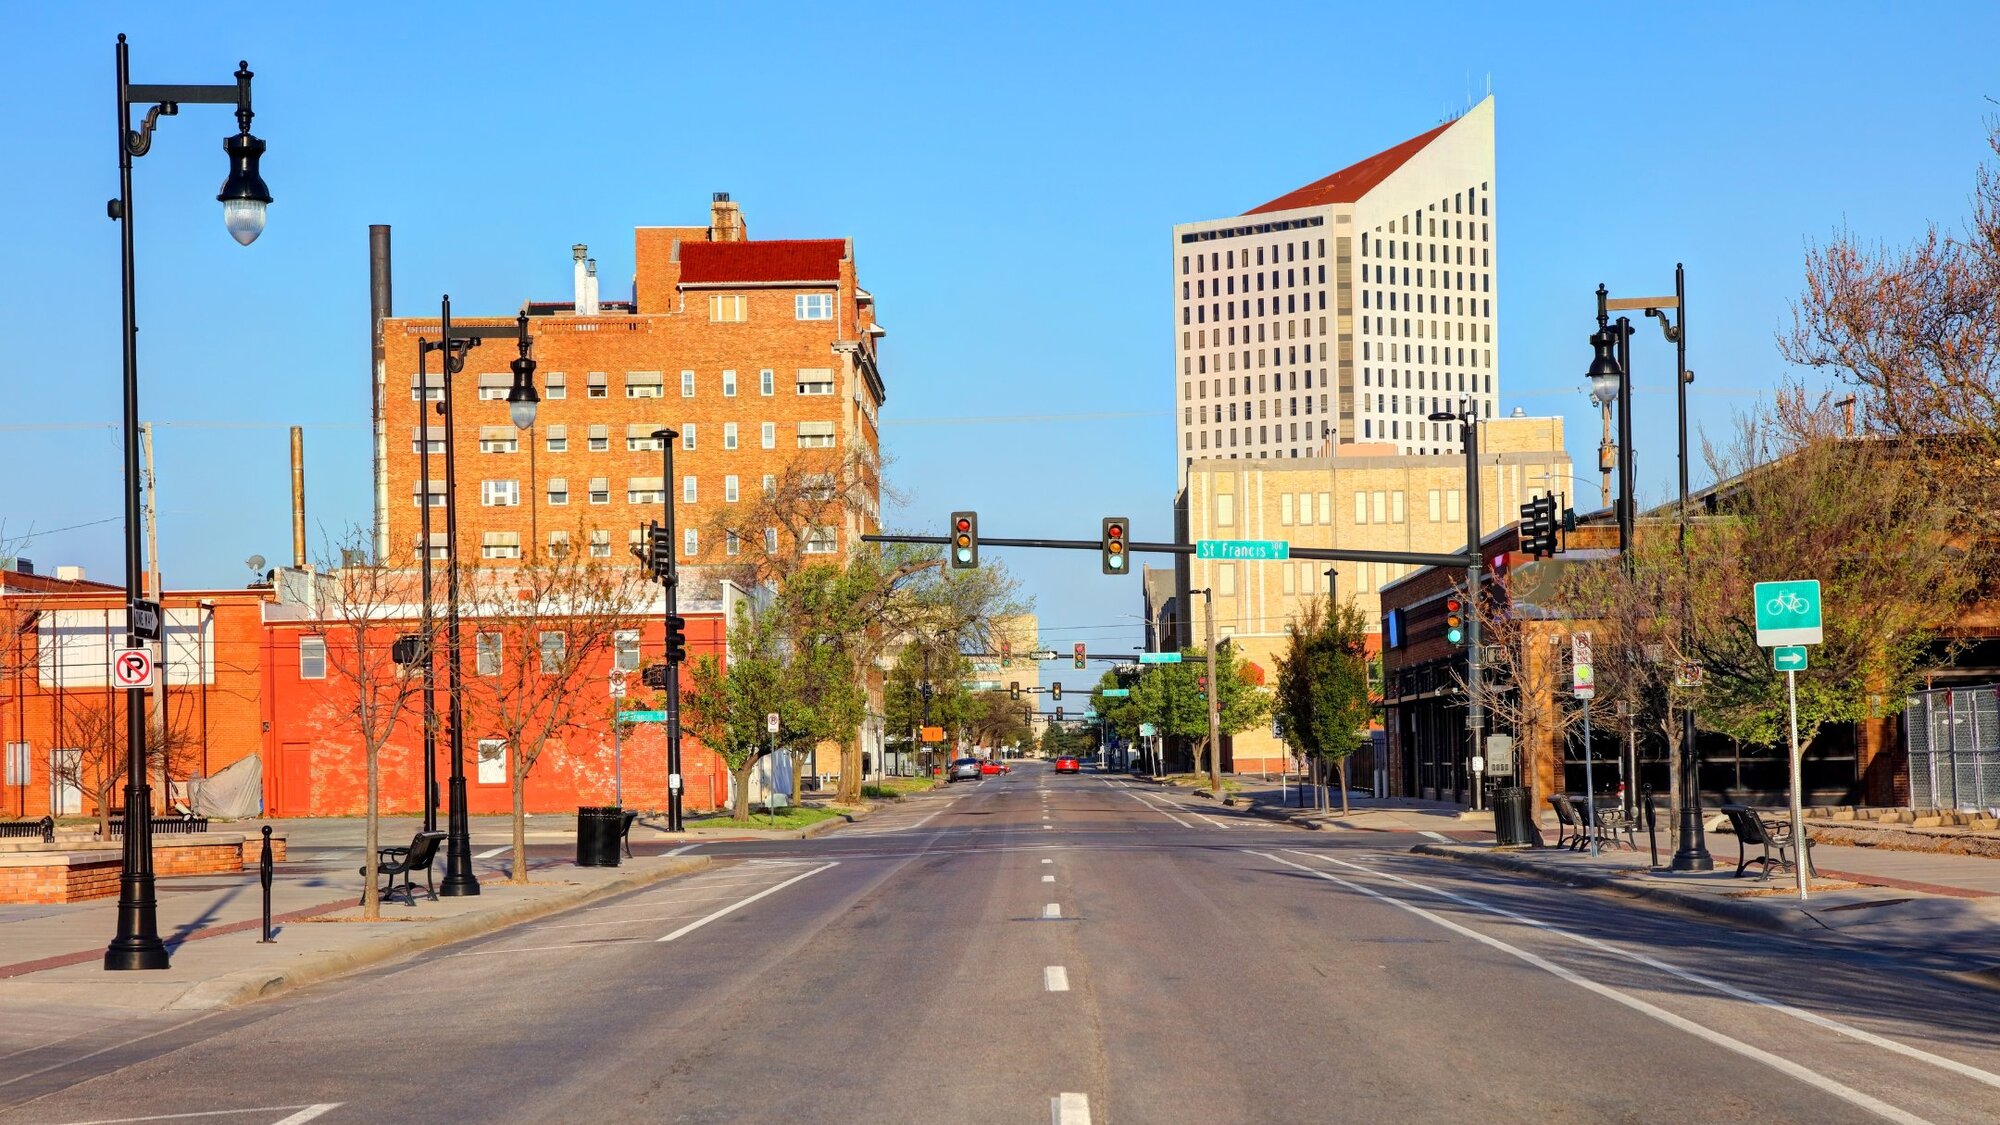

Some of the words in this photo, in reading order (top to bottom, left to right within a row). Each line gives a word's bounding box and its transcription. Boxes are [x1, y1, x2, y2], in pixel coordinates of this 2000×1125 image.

[1202, 541, 1214, 557] St
[1222, 542, 1266, 558] Francis
[135, 609, 144, 627] ONE
[144, 611, 153, 629] WAY
[127, 657, 144, 678] P
